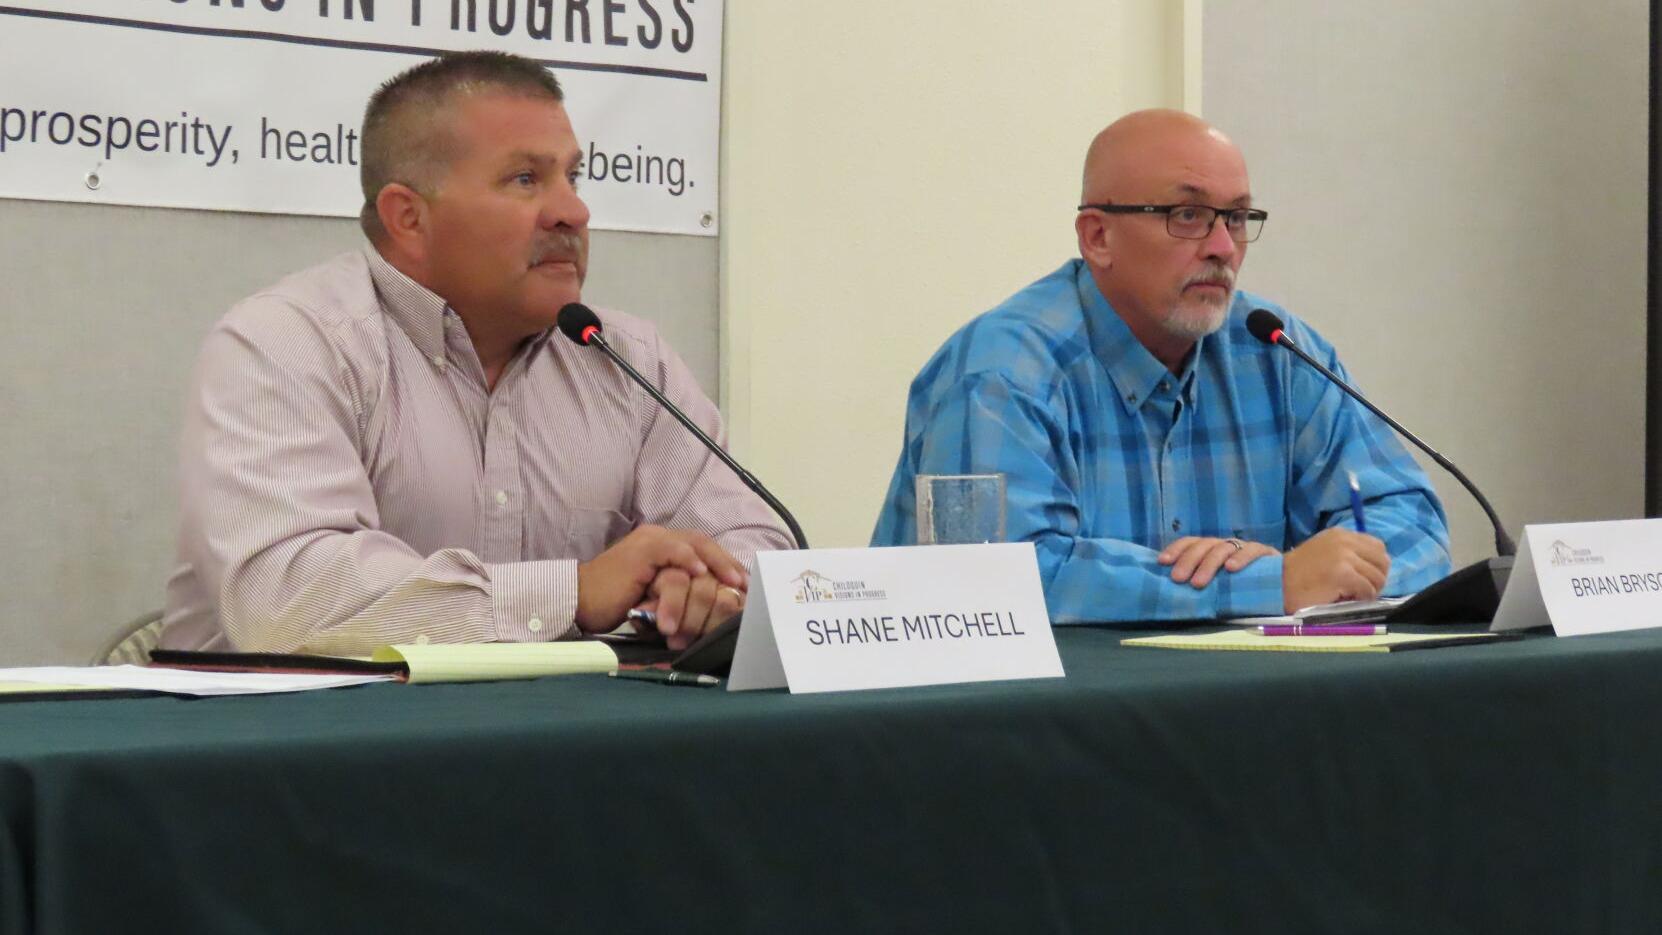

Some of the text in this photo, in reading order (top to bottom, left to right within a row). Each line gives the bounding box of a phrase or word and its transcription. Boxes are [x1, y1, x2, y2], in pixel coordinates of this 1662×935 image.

[0, 107, 239, 167] prosperity,
[260, 117, 358, 166] healt
[1571, 576, 1620, 597] BRIAN
[806, 612, 1025, 645] SHANE MITCHELL
